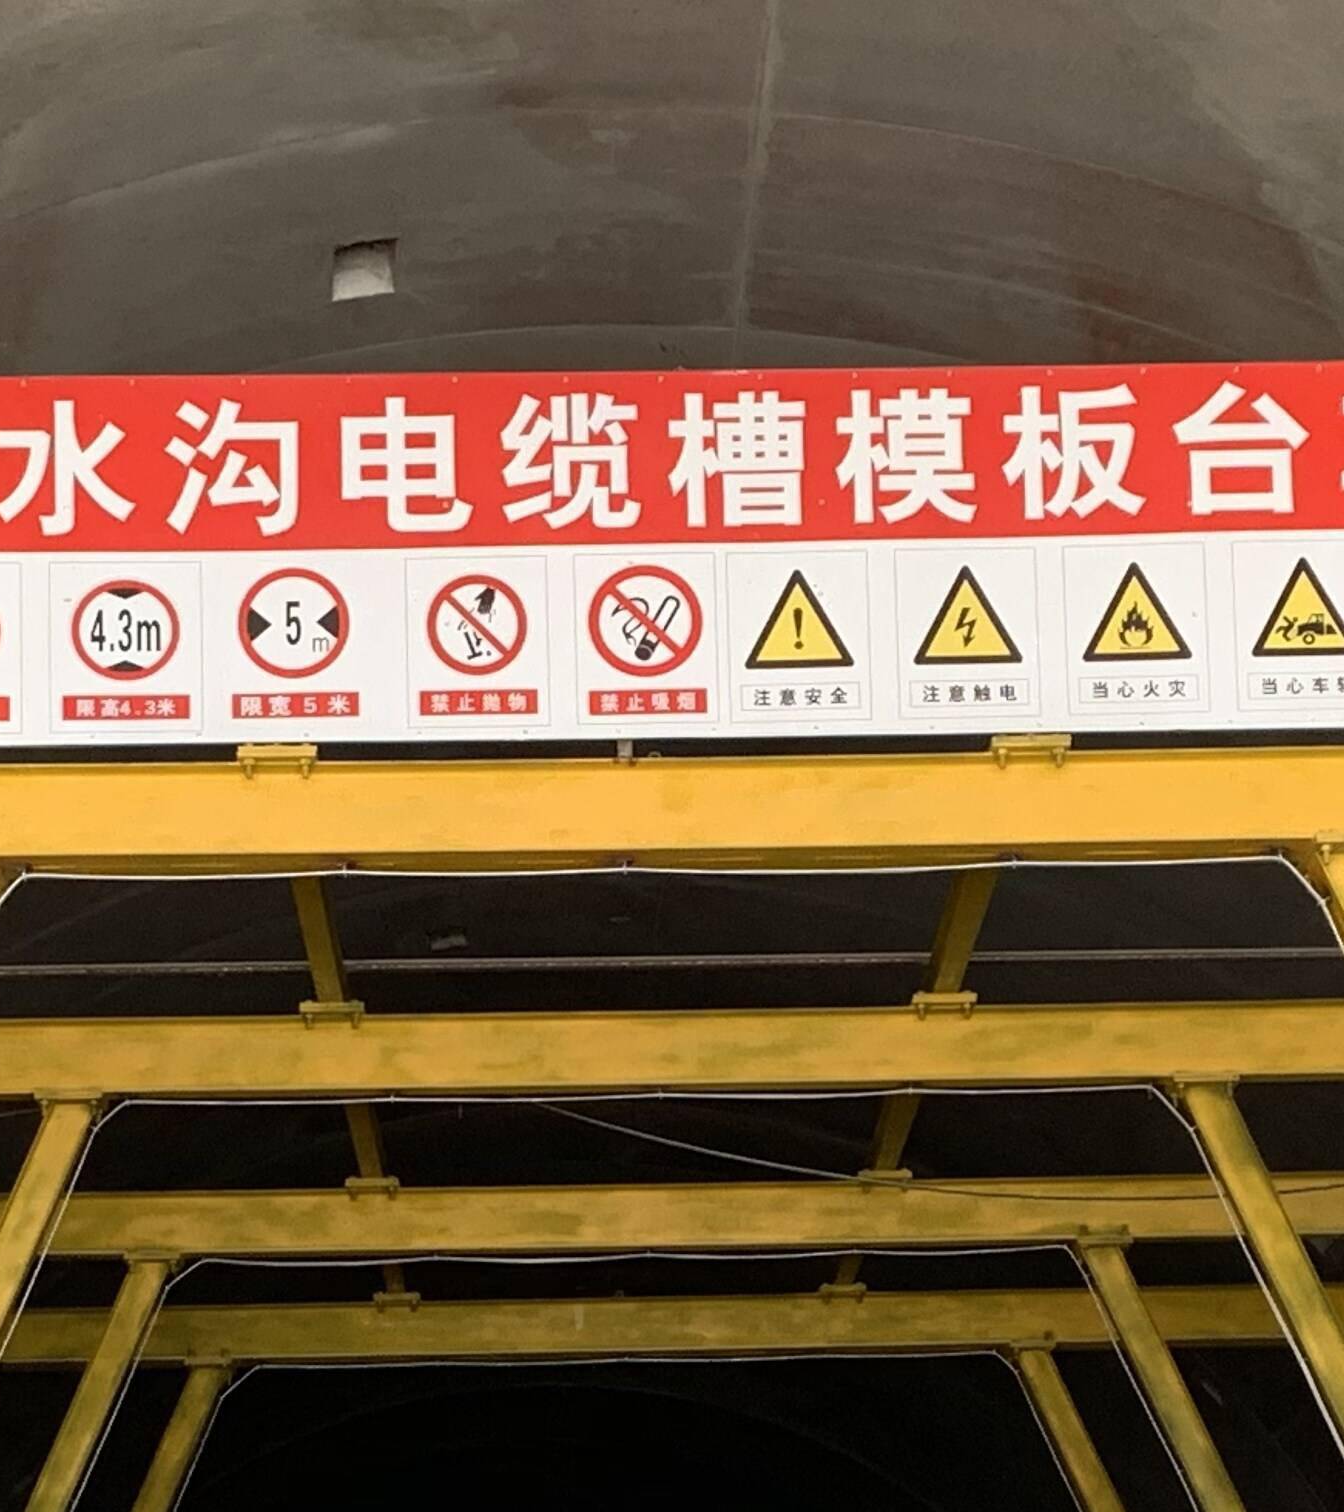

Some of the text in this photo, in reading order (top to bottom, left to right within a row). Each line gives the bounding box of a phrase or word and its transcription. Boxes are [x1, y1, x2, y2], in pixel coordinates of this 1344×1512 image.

[90, 609, 161, 652] 4.3m
[753, 686, 848, 706] 注意安全
[922, 683, 1018, 703] 注意触电
[1092, 679, 1187, 699] 当心火灾
[76, 698, 177, 718] 限高4.3米
[600, 691, 697, 713] 禁止吸烟
